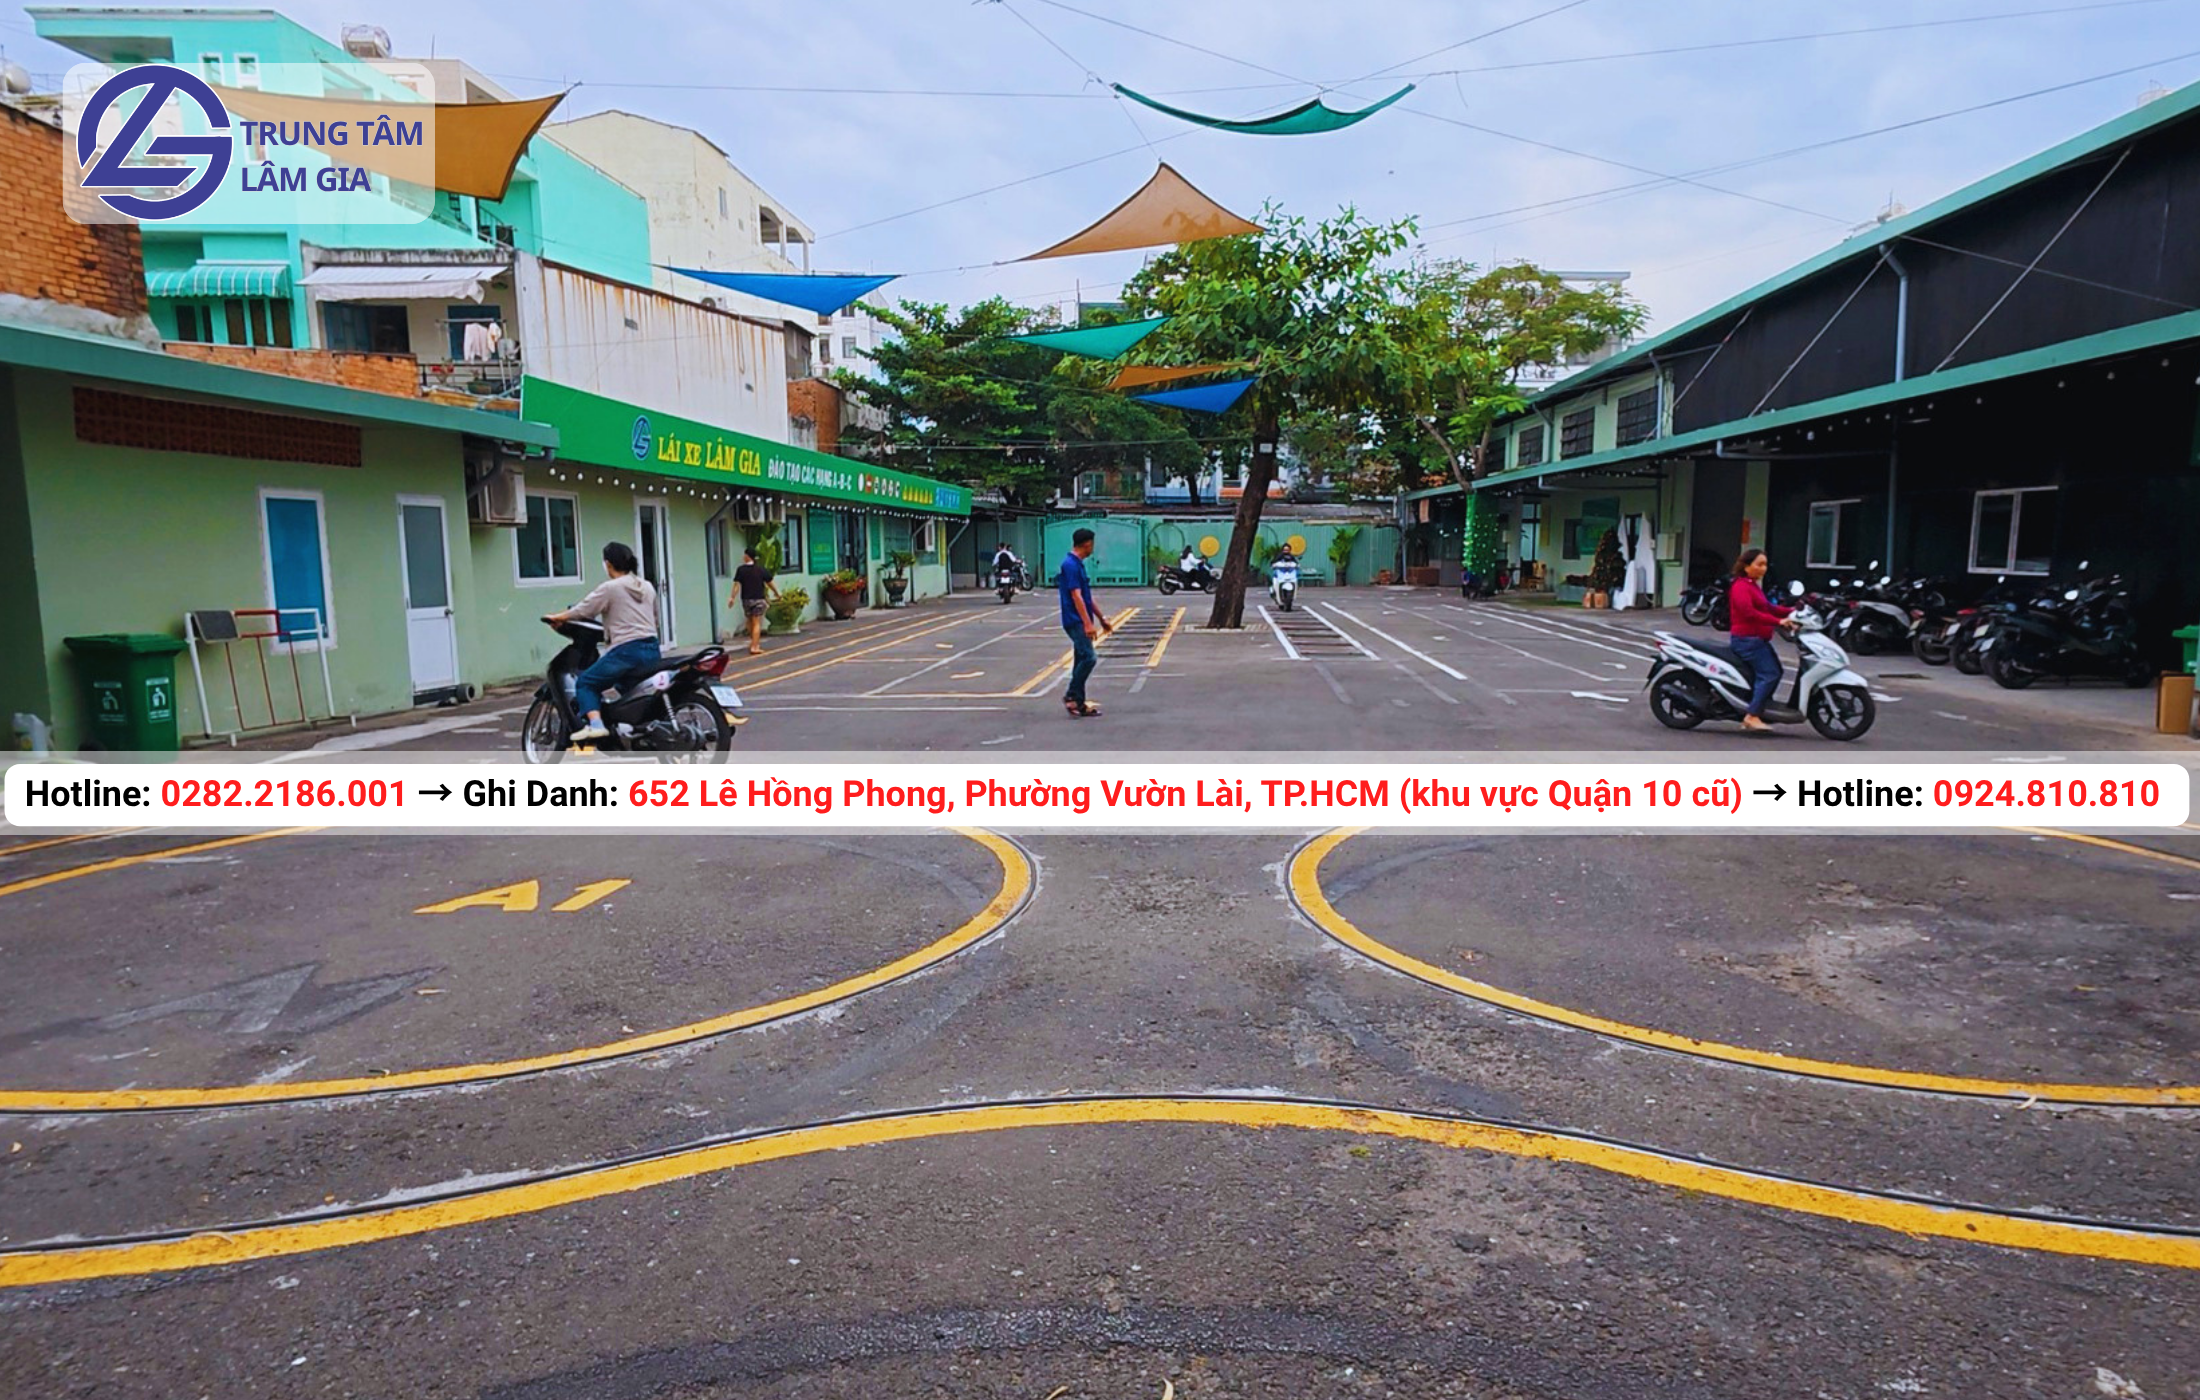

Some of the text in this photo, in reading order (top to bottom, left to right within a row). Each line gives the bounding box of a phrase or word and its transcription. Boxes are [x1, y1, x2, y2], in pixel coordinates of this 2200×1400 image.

[658, 432, 761, 476] LÁI XE LÂM GIA
[413, 878, 633, 914] A1
